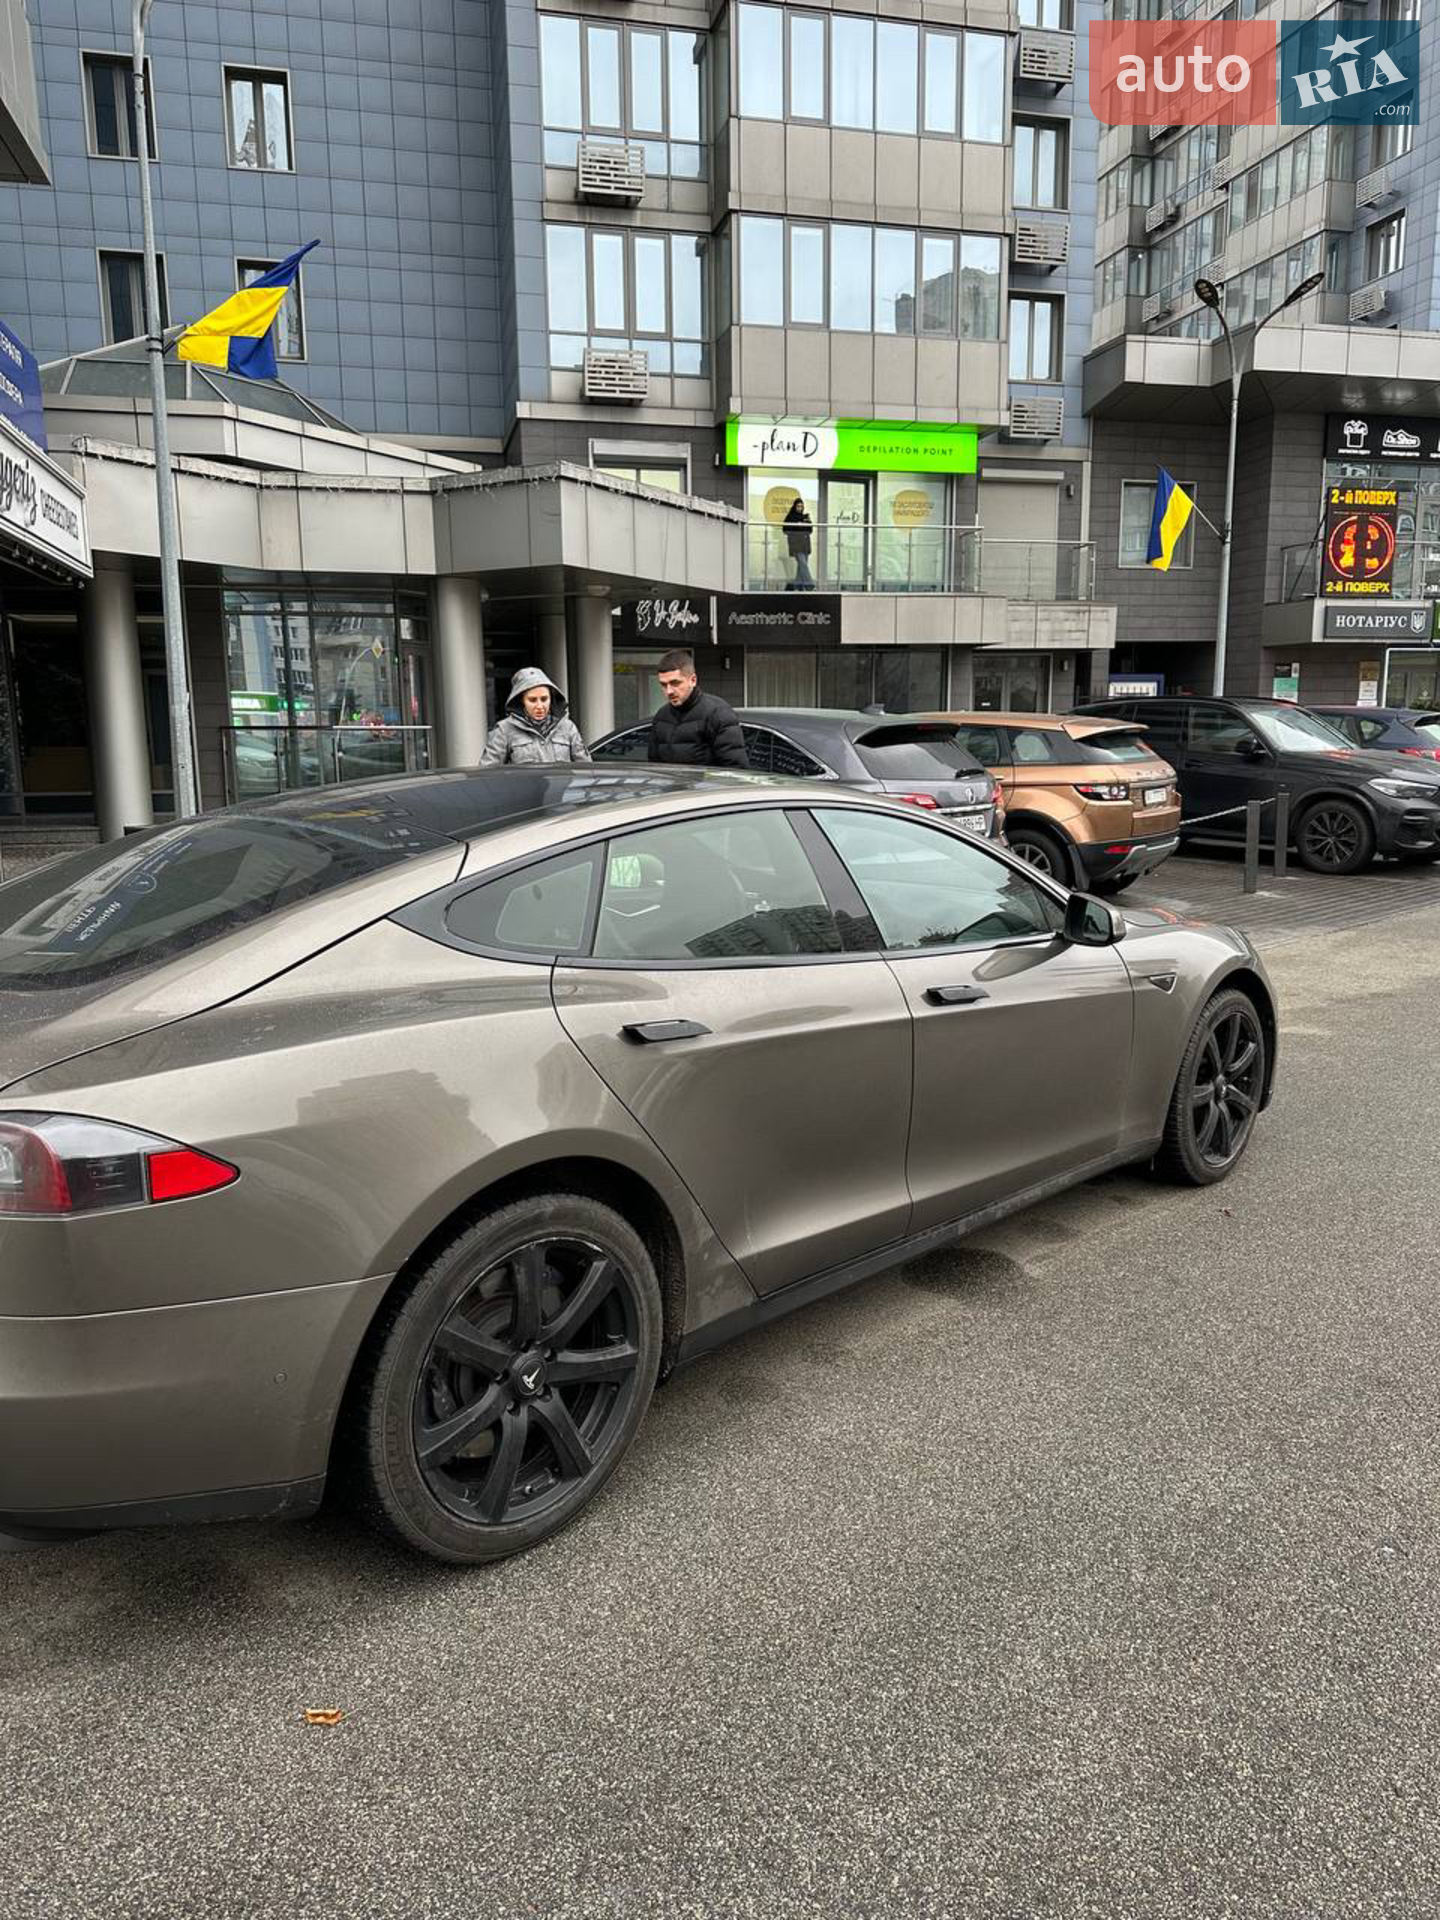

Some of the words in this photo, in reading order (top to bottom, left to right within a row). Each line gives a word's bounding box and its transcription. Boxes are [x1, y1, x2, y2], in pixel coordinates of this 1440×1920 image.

[859, 445, 919, 455] DEPILATION
[923, 448, 954, 456] POINT
[1354, 490, 1397, 505] ПОВЕРХ
[1345, 582, 1390, 593] ПОВЕРХ
[728, 611, 794, 625] Aesthetic
[797, 611, 831, 625] Clinic
[1336, 615, 1407, 628] НОТАРІУС
